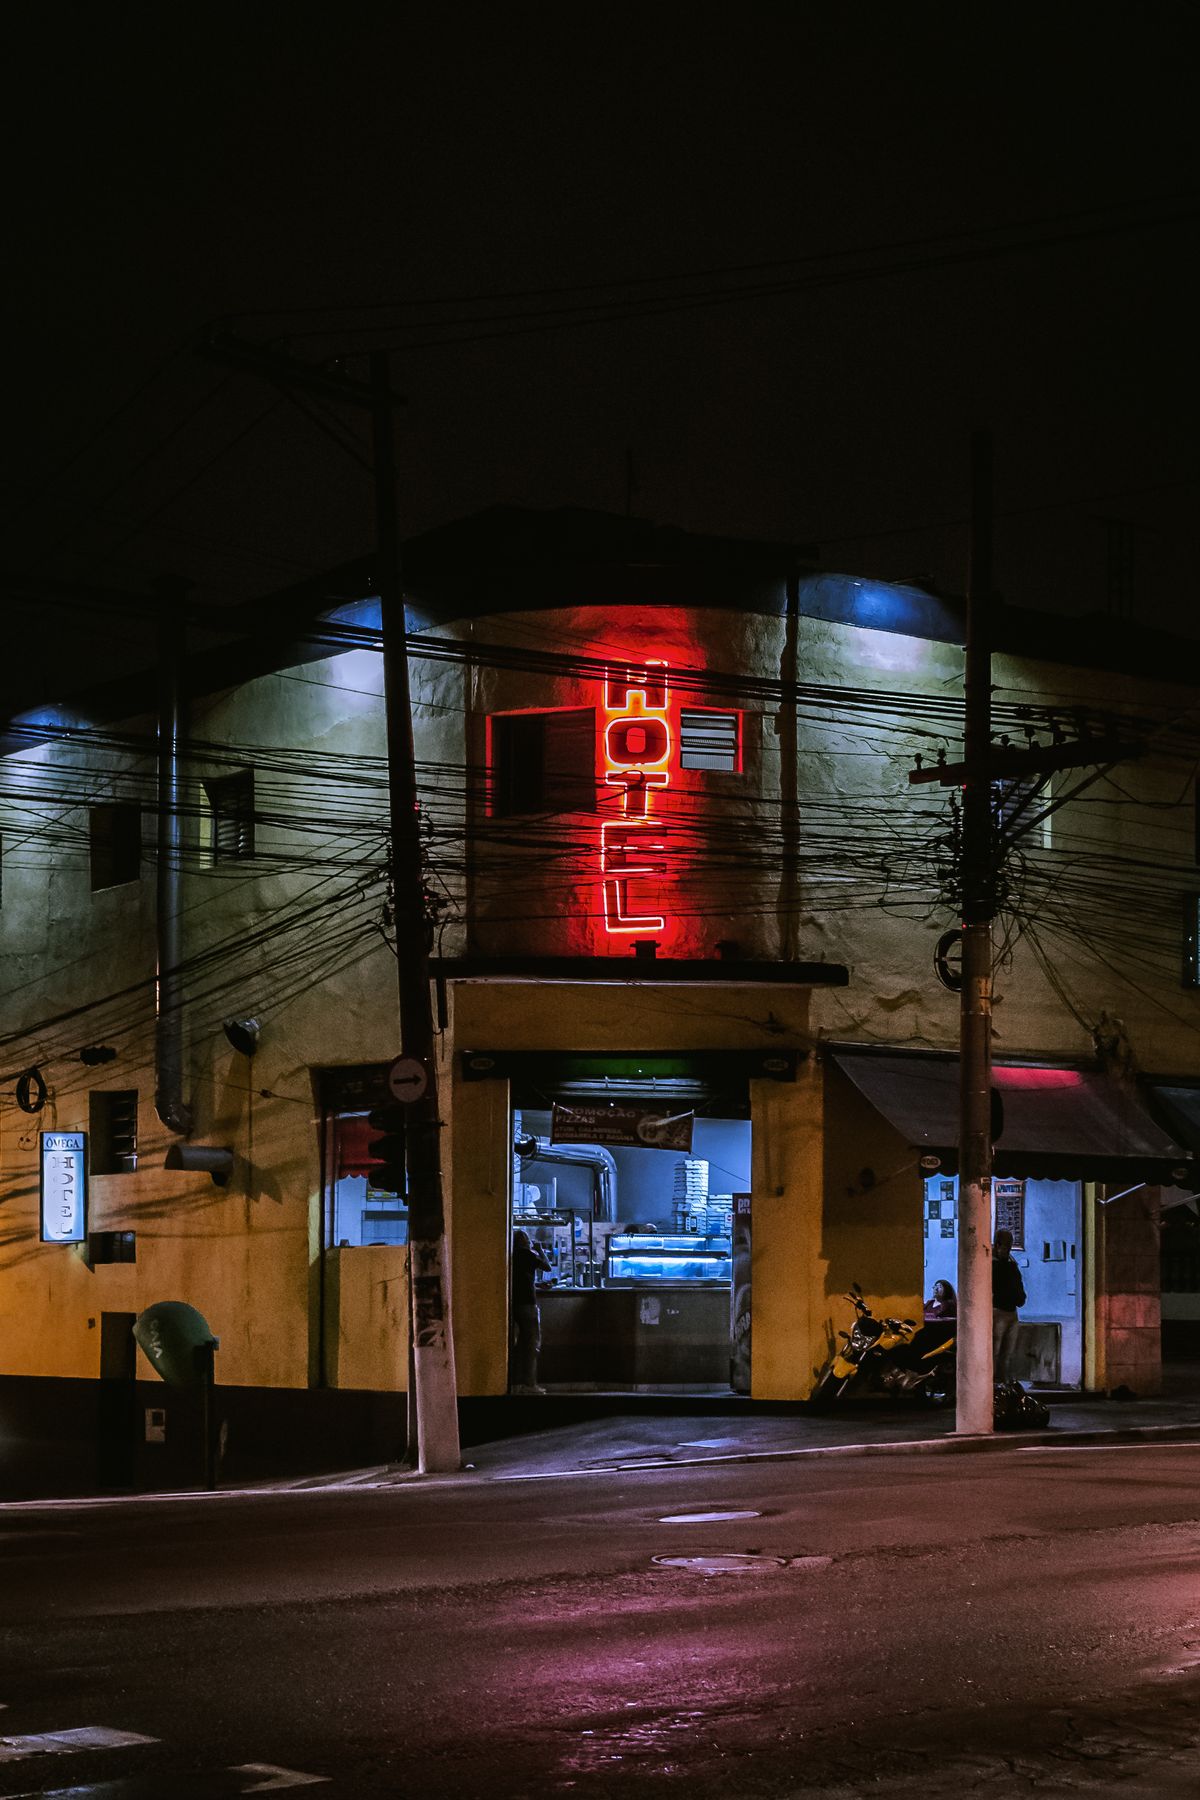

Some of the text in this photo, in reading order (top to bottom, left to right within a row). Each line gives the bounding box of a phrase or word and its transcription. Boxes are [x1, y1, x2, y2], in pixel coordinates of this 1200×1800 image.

[601, 659, 670, 933] HOTEL
[46, 1137, 80, 1149] ÔMEGA
[52, 1157, 74, 1235] HOTEL
